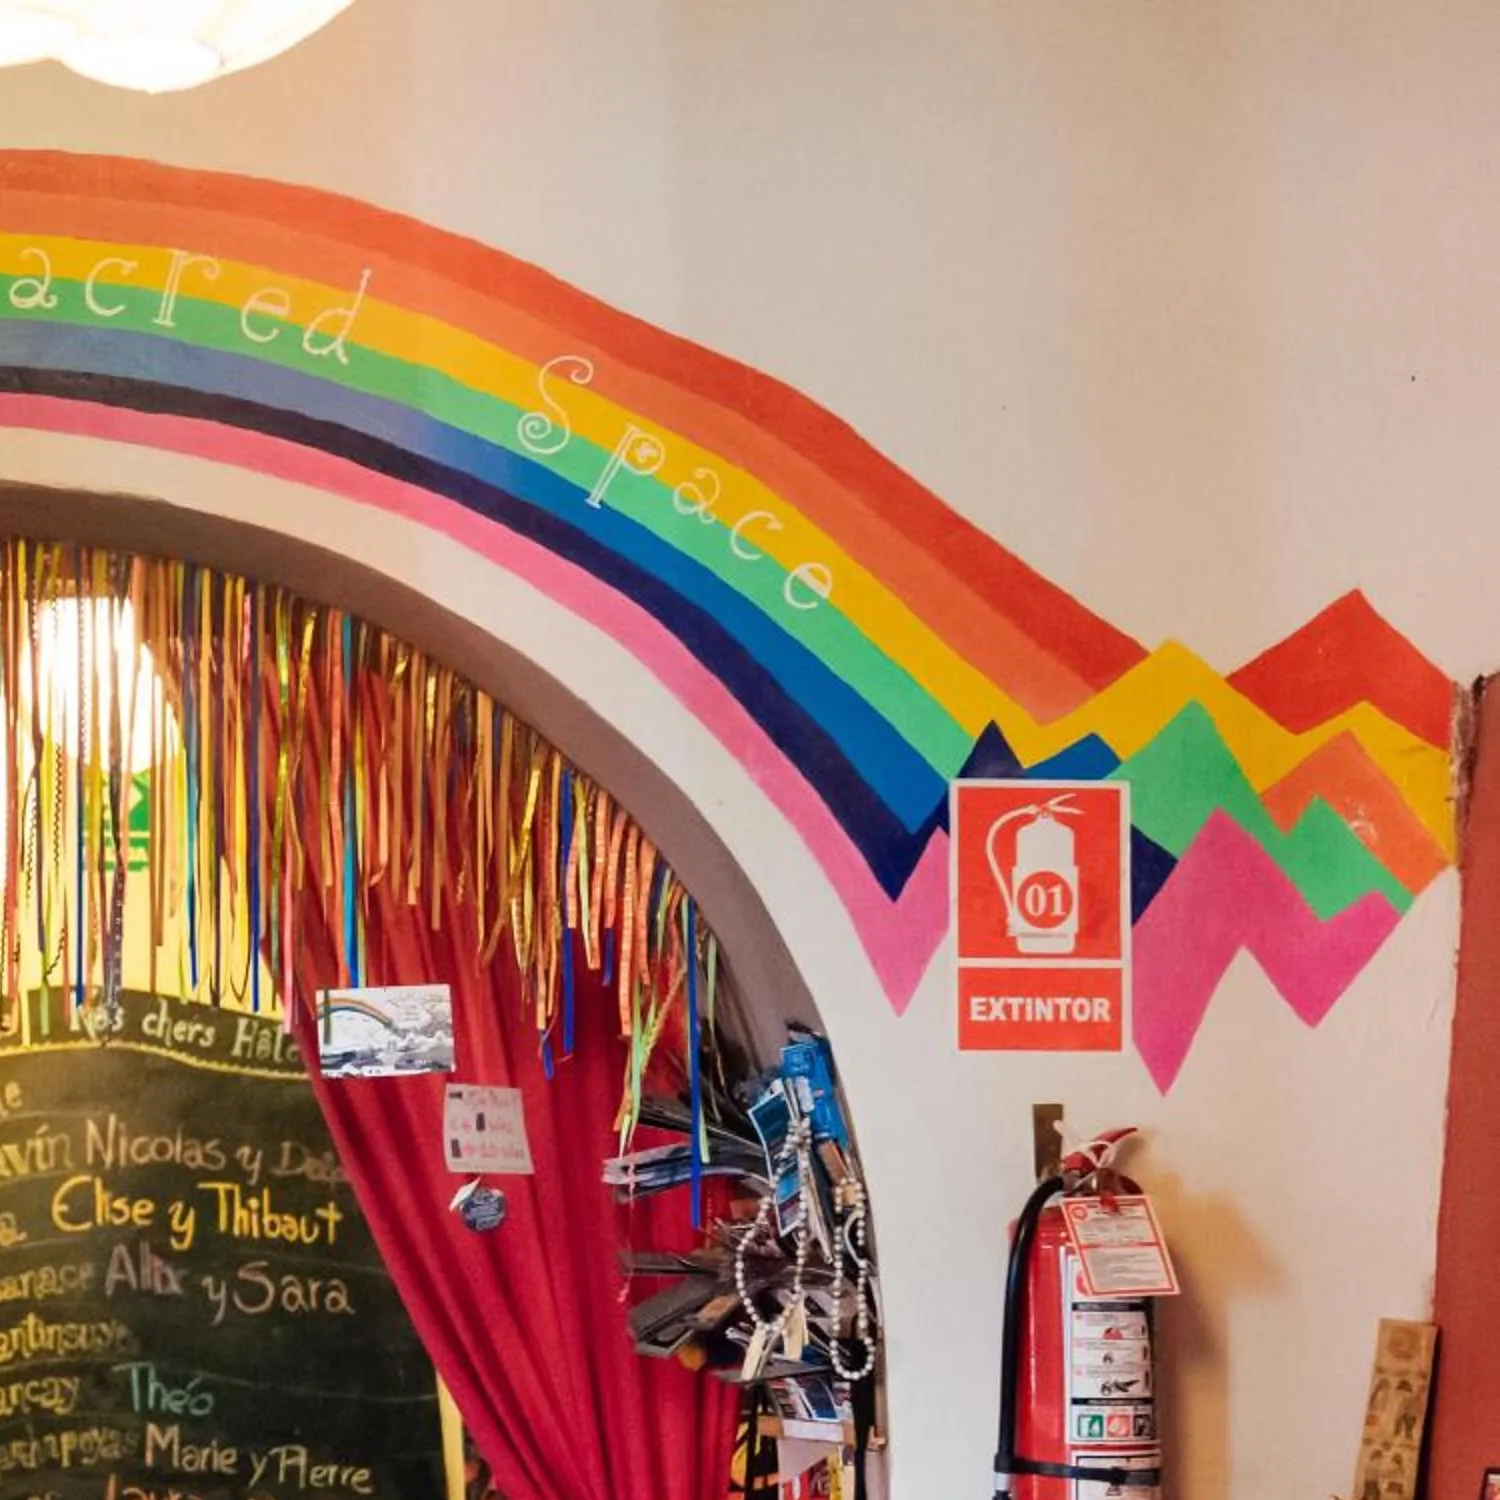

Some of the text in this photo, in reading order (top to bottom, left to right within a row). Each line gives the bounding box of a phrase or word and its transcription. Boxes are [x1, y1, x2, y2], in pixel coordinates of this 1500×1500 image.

[516, 353, 834, 609] Space
[1024, 882, 1066, 917] 01
[142, 997, 217, 1049] chers
[969, 996, 1112, 1023] EXTINTOR
[86, 1112, 227, 1172] Nicolas
[237, 1146, 263, 1186] y
[167, 1200, 195, 1251] y
[197, 1181, 345, 1246] Thibaut
[201, 1276, 227, 1326] y
[233, 1260, 356, 1315] Sara
[144, 1423, 373, 1494] Marie y Pierre
